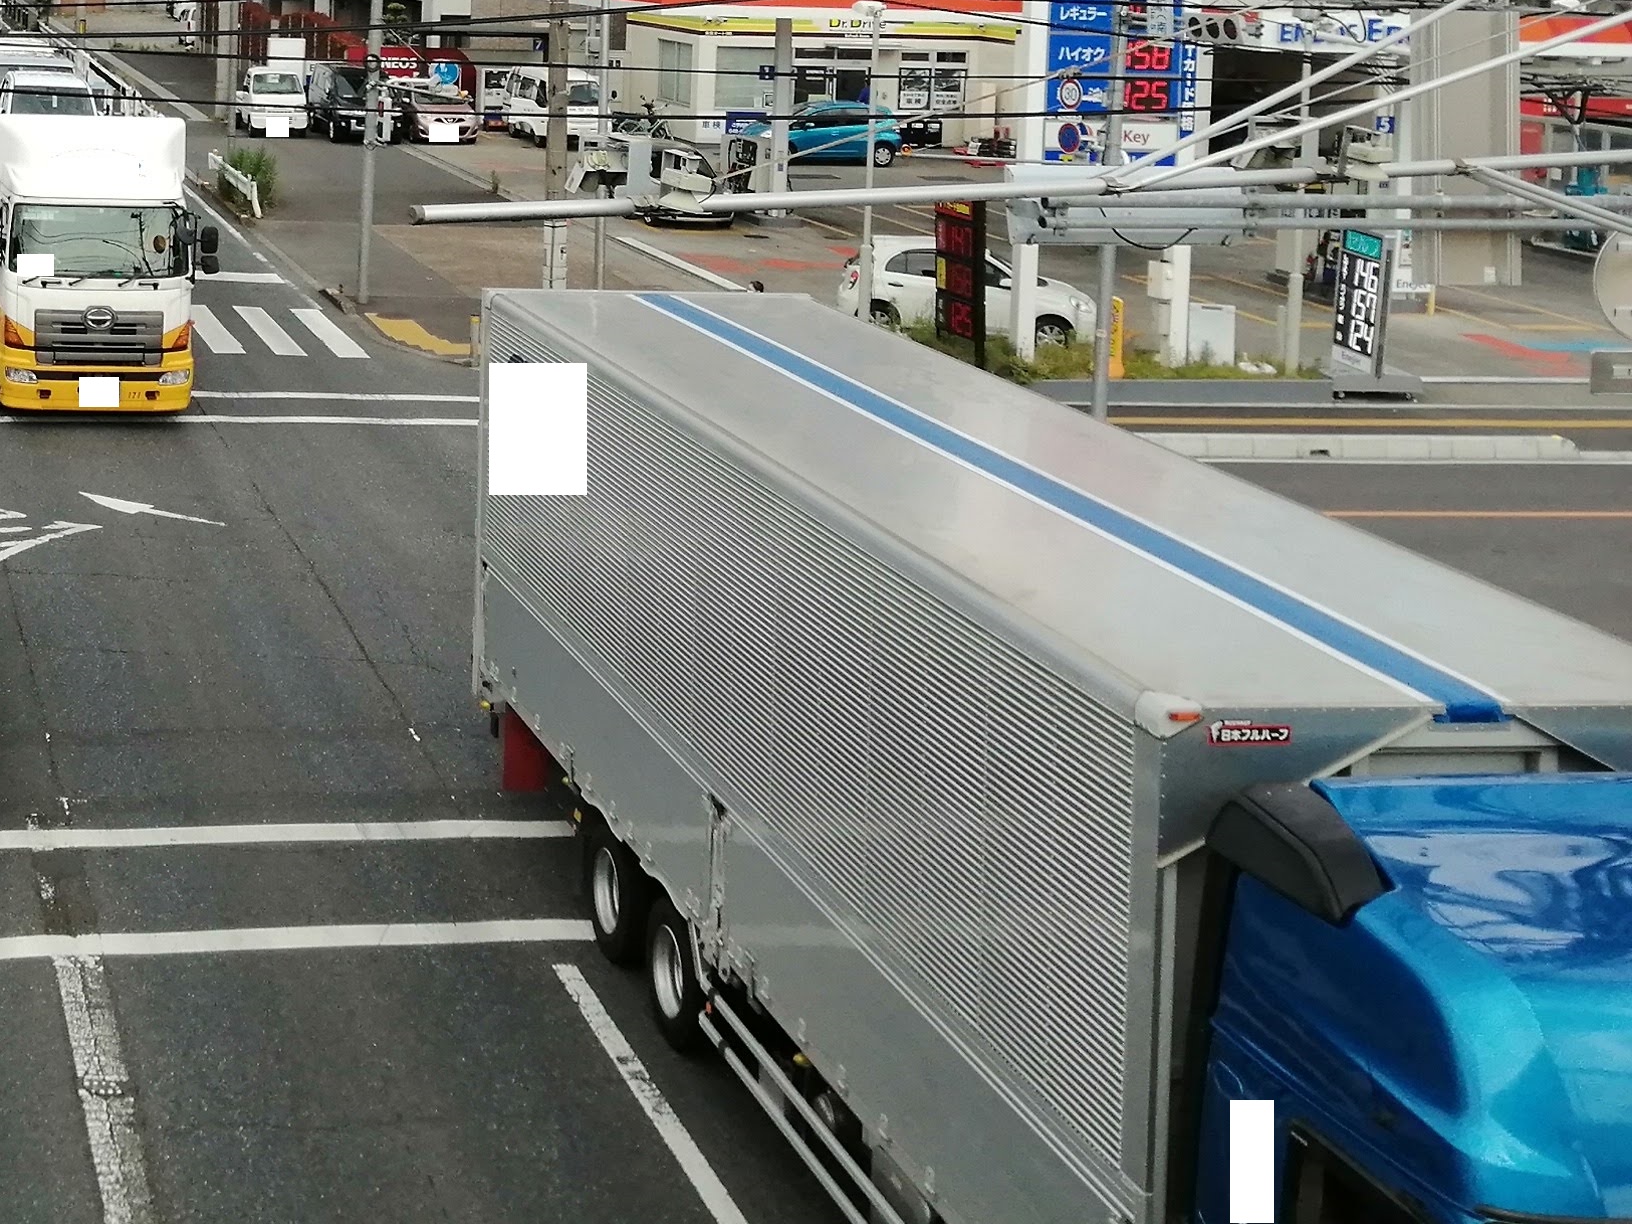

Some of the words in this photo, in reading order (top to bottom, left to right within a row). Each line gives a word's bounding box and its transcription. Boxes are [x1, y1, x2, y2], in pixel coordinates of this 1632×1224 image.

[1060, 6, 1107, 20] レギュラー
[850, 19, 886, 29] Drie
[1058, 46, 1105, 62] ハイオク
[380, 58, 417, 69] NEOS
[1064, 87, 1077, 102] 30
[1123, 81, 1168, 110] 125
[1380, 118, 1390, 132] 5
[1354, 258, 1380, 293] 146
[1351, 288, 1377, 324] 157
[1348, 319, 1374, 355] 124
[1221, 729, 1289, 741] 日本フルハーフ
